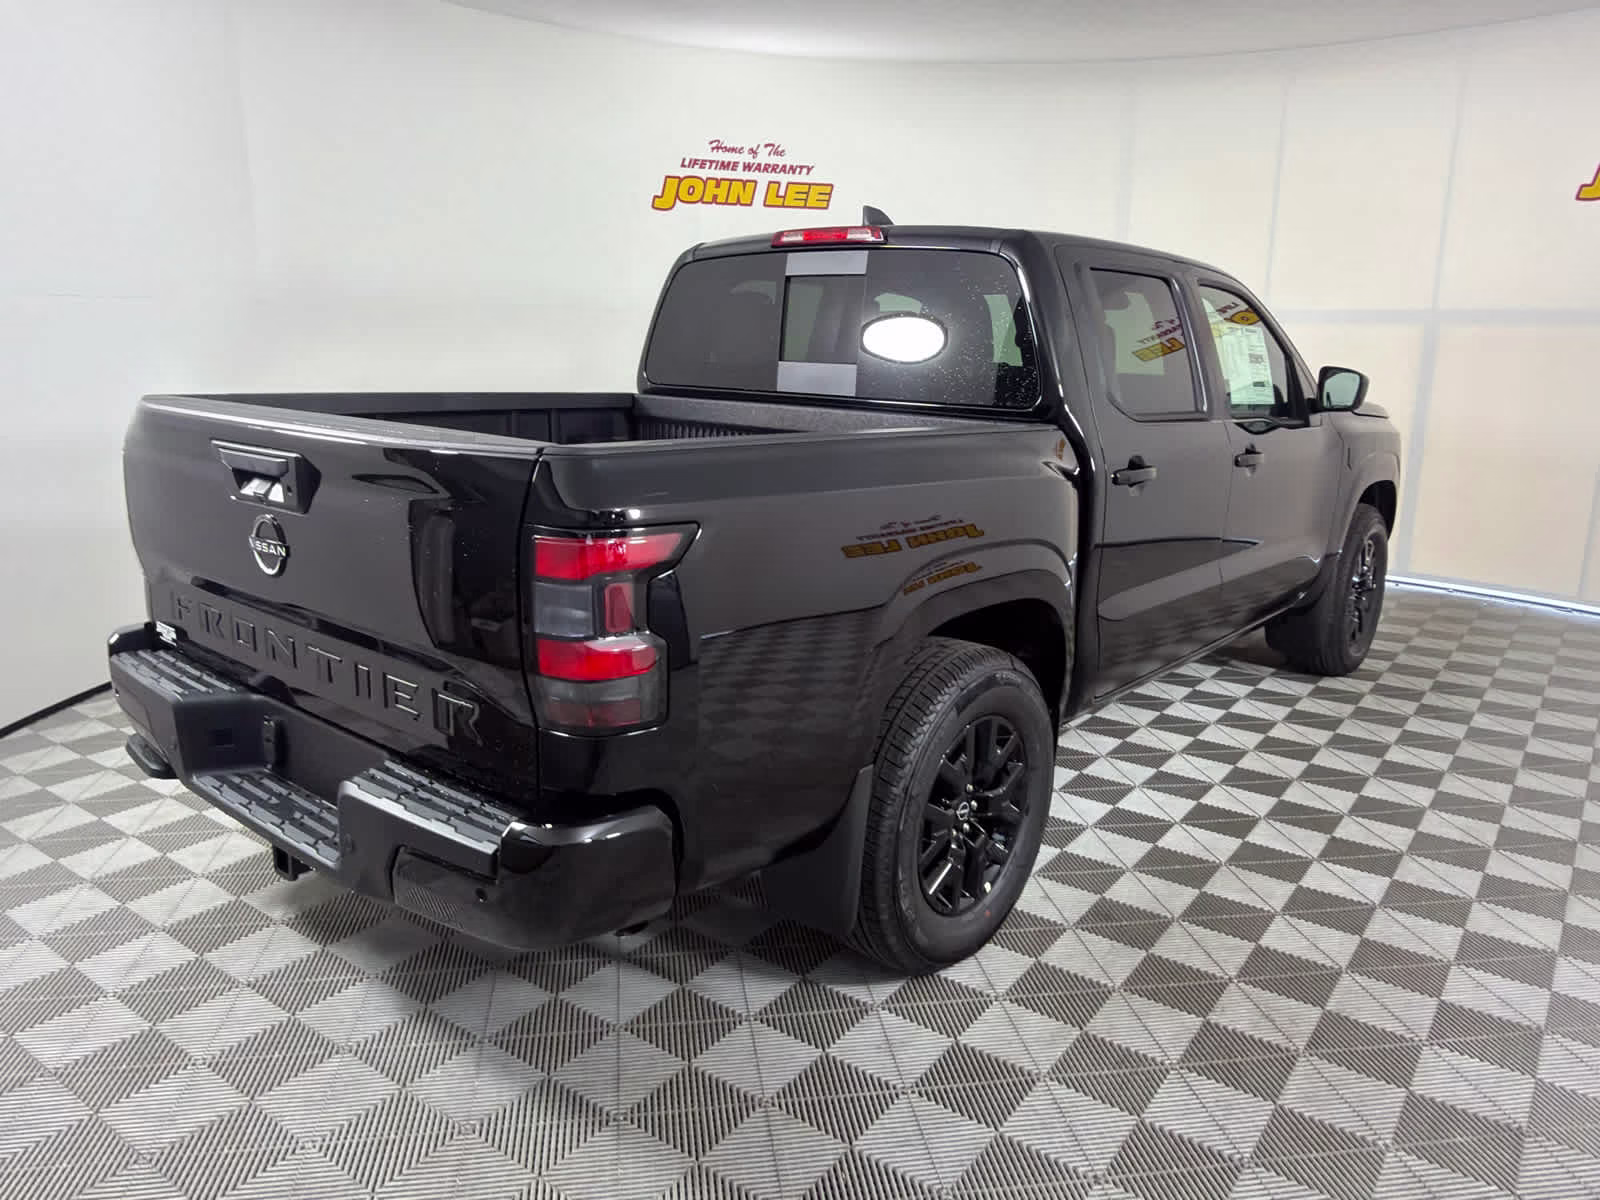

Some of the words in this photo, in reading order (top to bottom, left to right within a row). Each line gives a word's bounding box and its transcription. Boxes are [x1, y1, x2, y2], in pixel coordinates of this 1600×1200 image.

[708, 139, 745, 155] Home
[747, 144, 761, 159] of
[763, 143, 786, 157] The
[680, 157, 740, 172] LIFETIME
[742, 161, 815, 176] WARRANTY
[651, 175, 757, 211] JOHN
[763, 181, 833, 209] LEE
[251, 537, 287, 557] SSAN
[170, 590, 484, 746] FRONTIER
